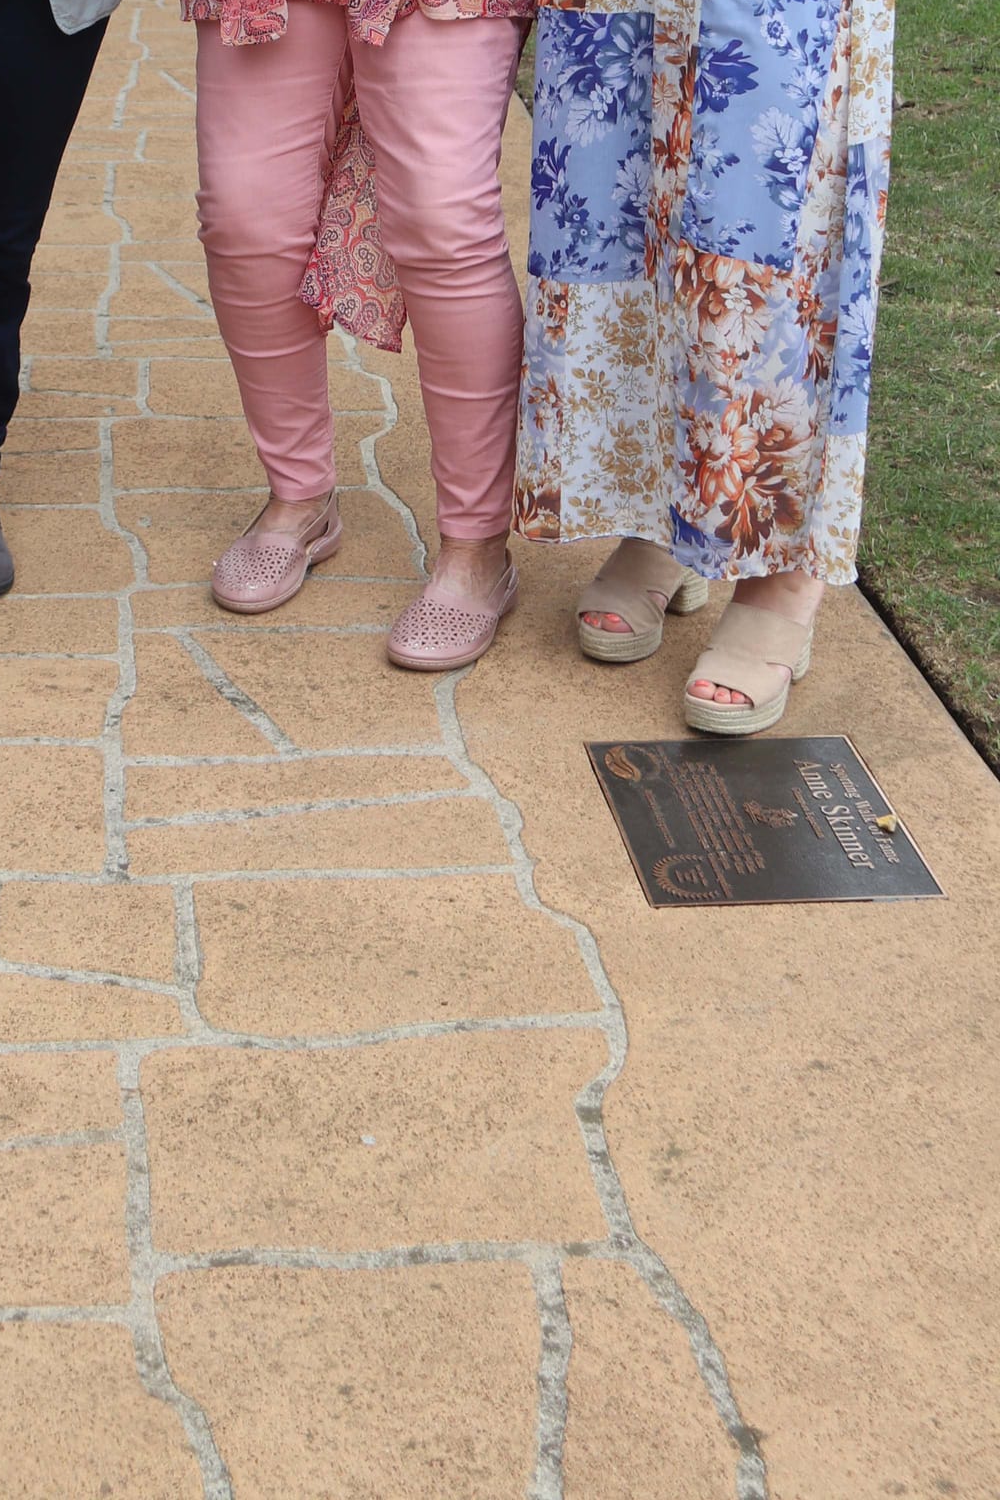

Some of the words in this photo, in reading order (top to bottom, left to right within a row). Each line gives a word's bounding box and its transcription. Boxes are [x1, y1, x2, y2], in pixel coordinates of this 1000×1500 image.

[792, 758, 833, 800] Anne
[820, 804, 876, 870] Skinner
[828, 763, 861, 799] Sporting
[854, 800, 881, 823] Walk
[875, 836, 901, 864] Fame
